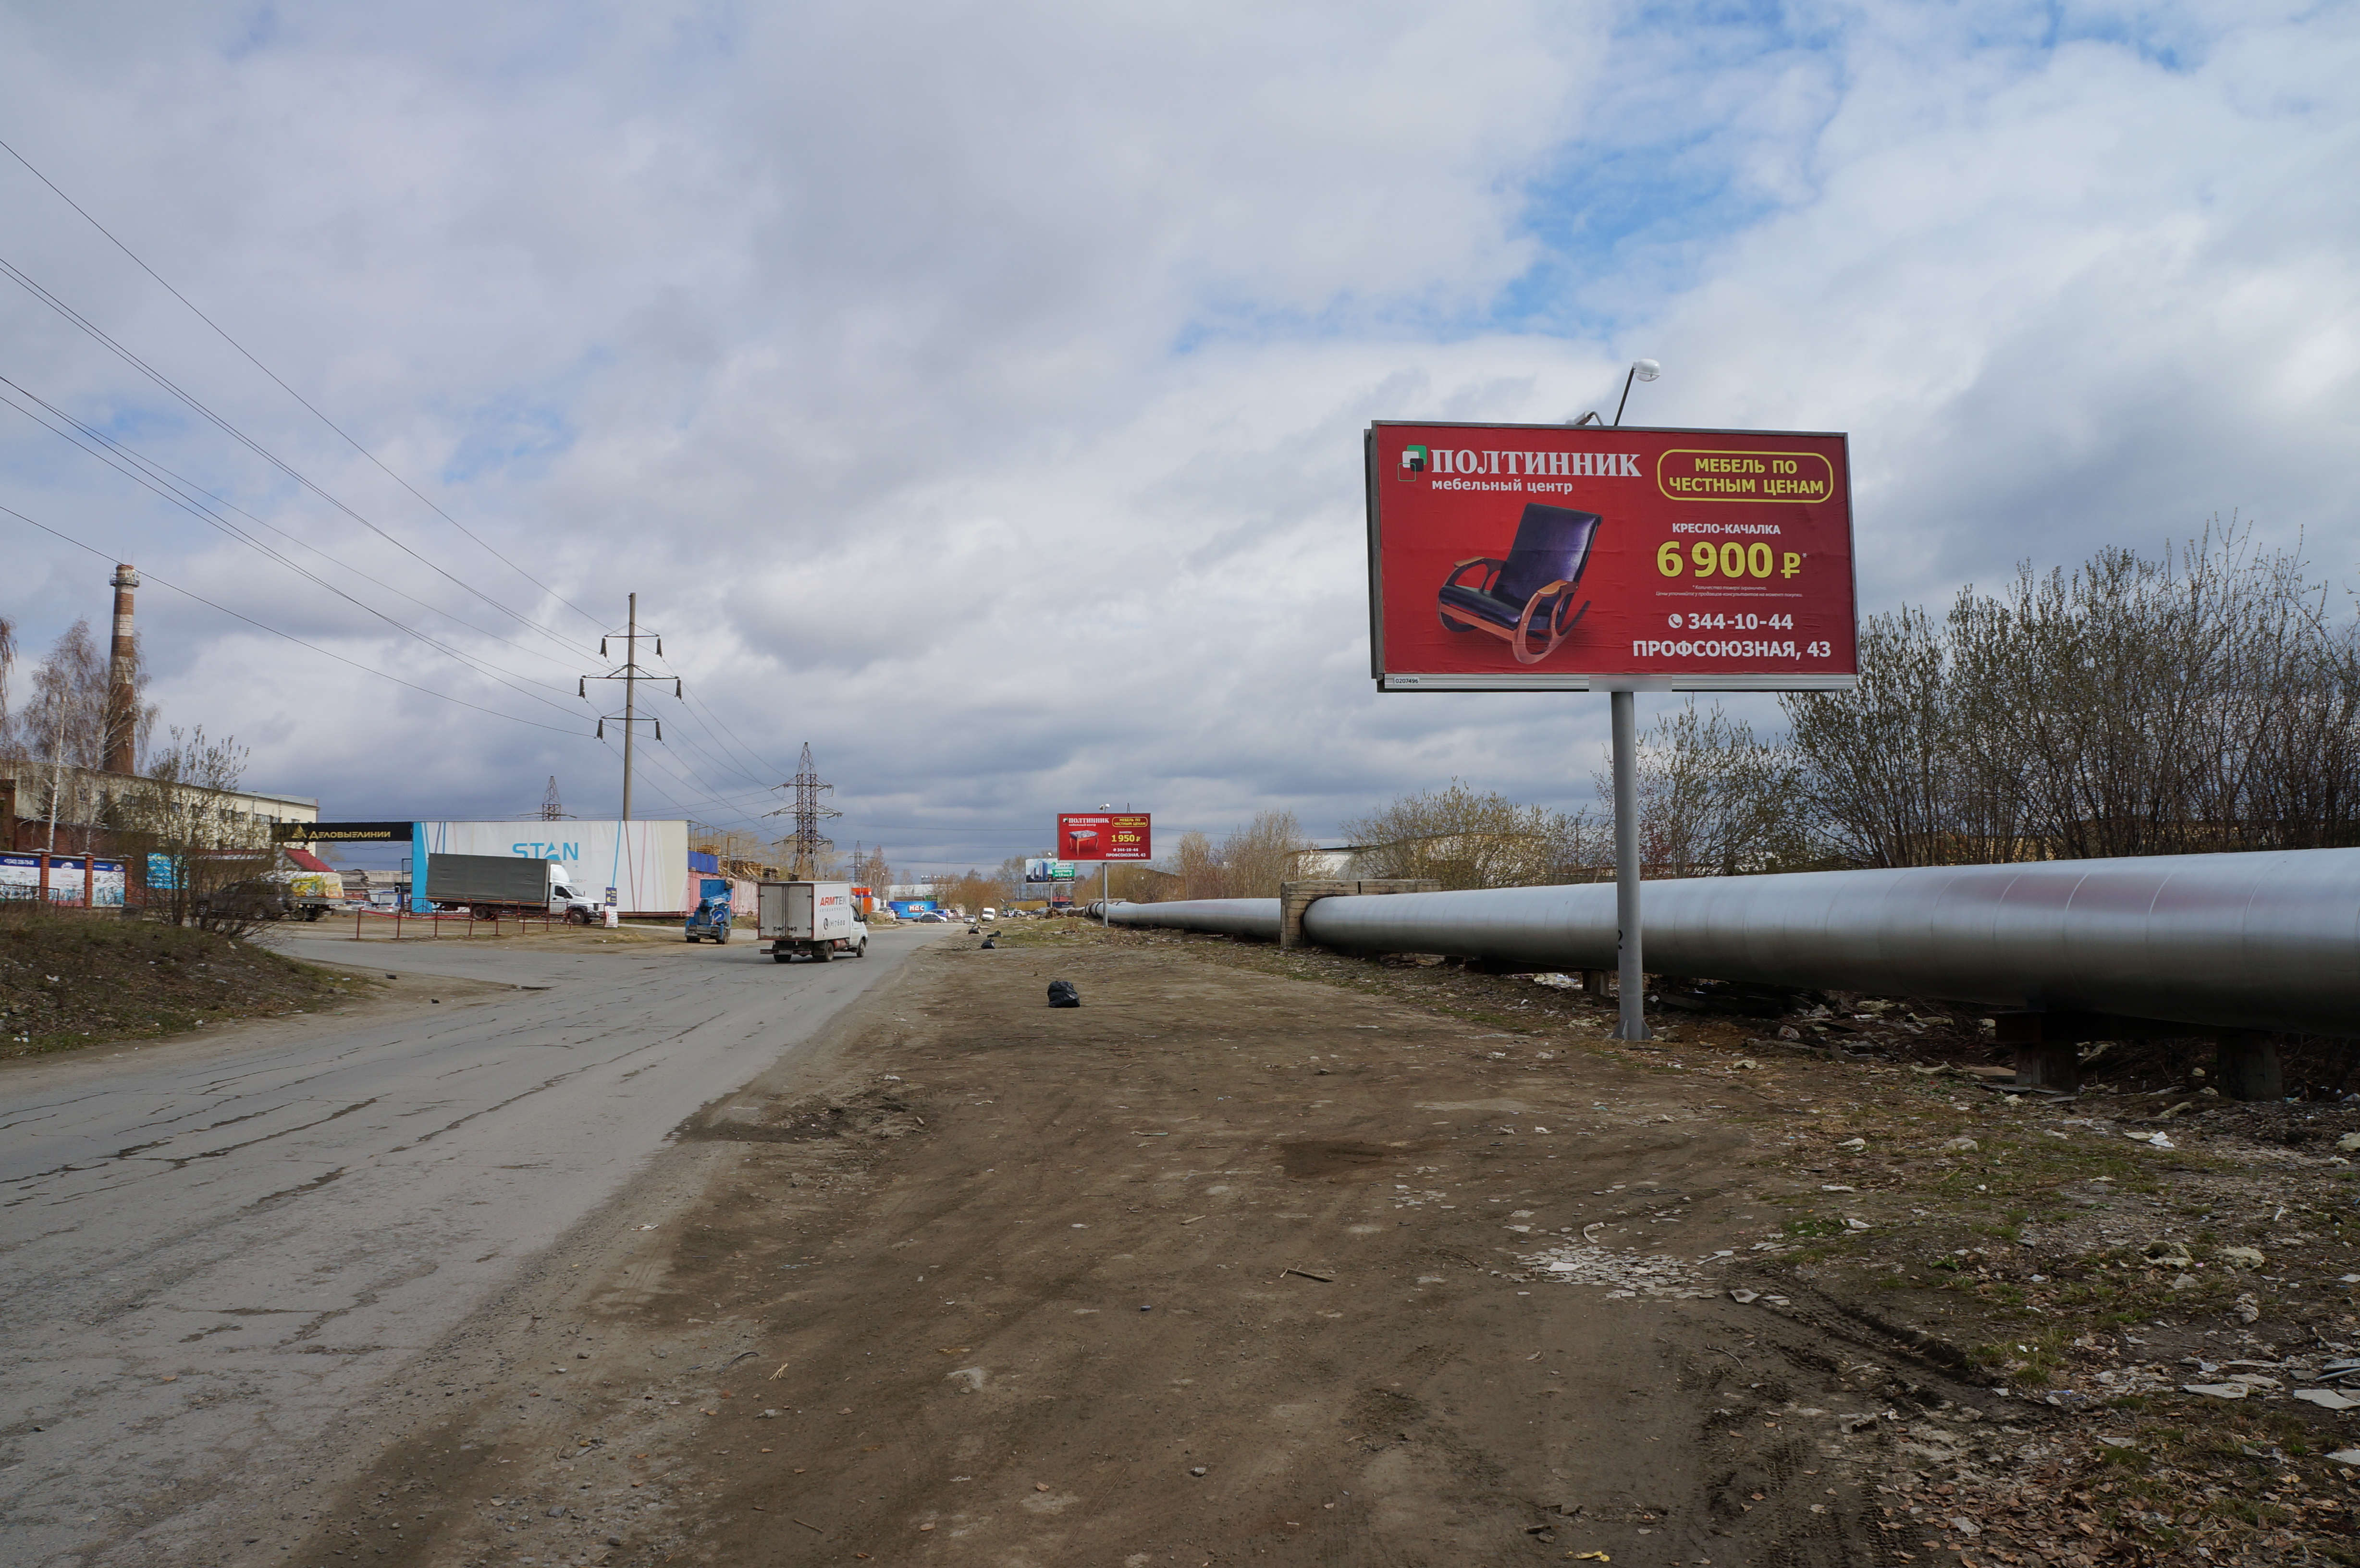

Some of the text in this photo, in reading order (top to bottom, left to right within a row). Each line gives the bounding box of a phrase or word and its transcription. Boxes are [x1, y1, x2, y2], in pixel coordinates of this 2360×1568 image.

[1431, 449, 1642, 477] ПОЛТИННИК
[1695, 458, 1797, 474] МЕБЕЛЬ ПО
[1432, 478, 1573, 495] мебельный центр
[1669, 477, 1824, 496] ЧЕСТНЫМ ЦЕНАМ
[1672, 523, 1781, 535] КРЕСЛО-КАЧАЛКА
[1688, 613, 1794, 630] 344-10-44
[1633, 640, 1831, 660] ПРОФСОЮЗНАЯ, 43
[512, 842, 578, 860] STAN
[820, 896, 848, 906] ARMTEK
